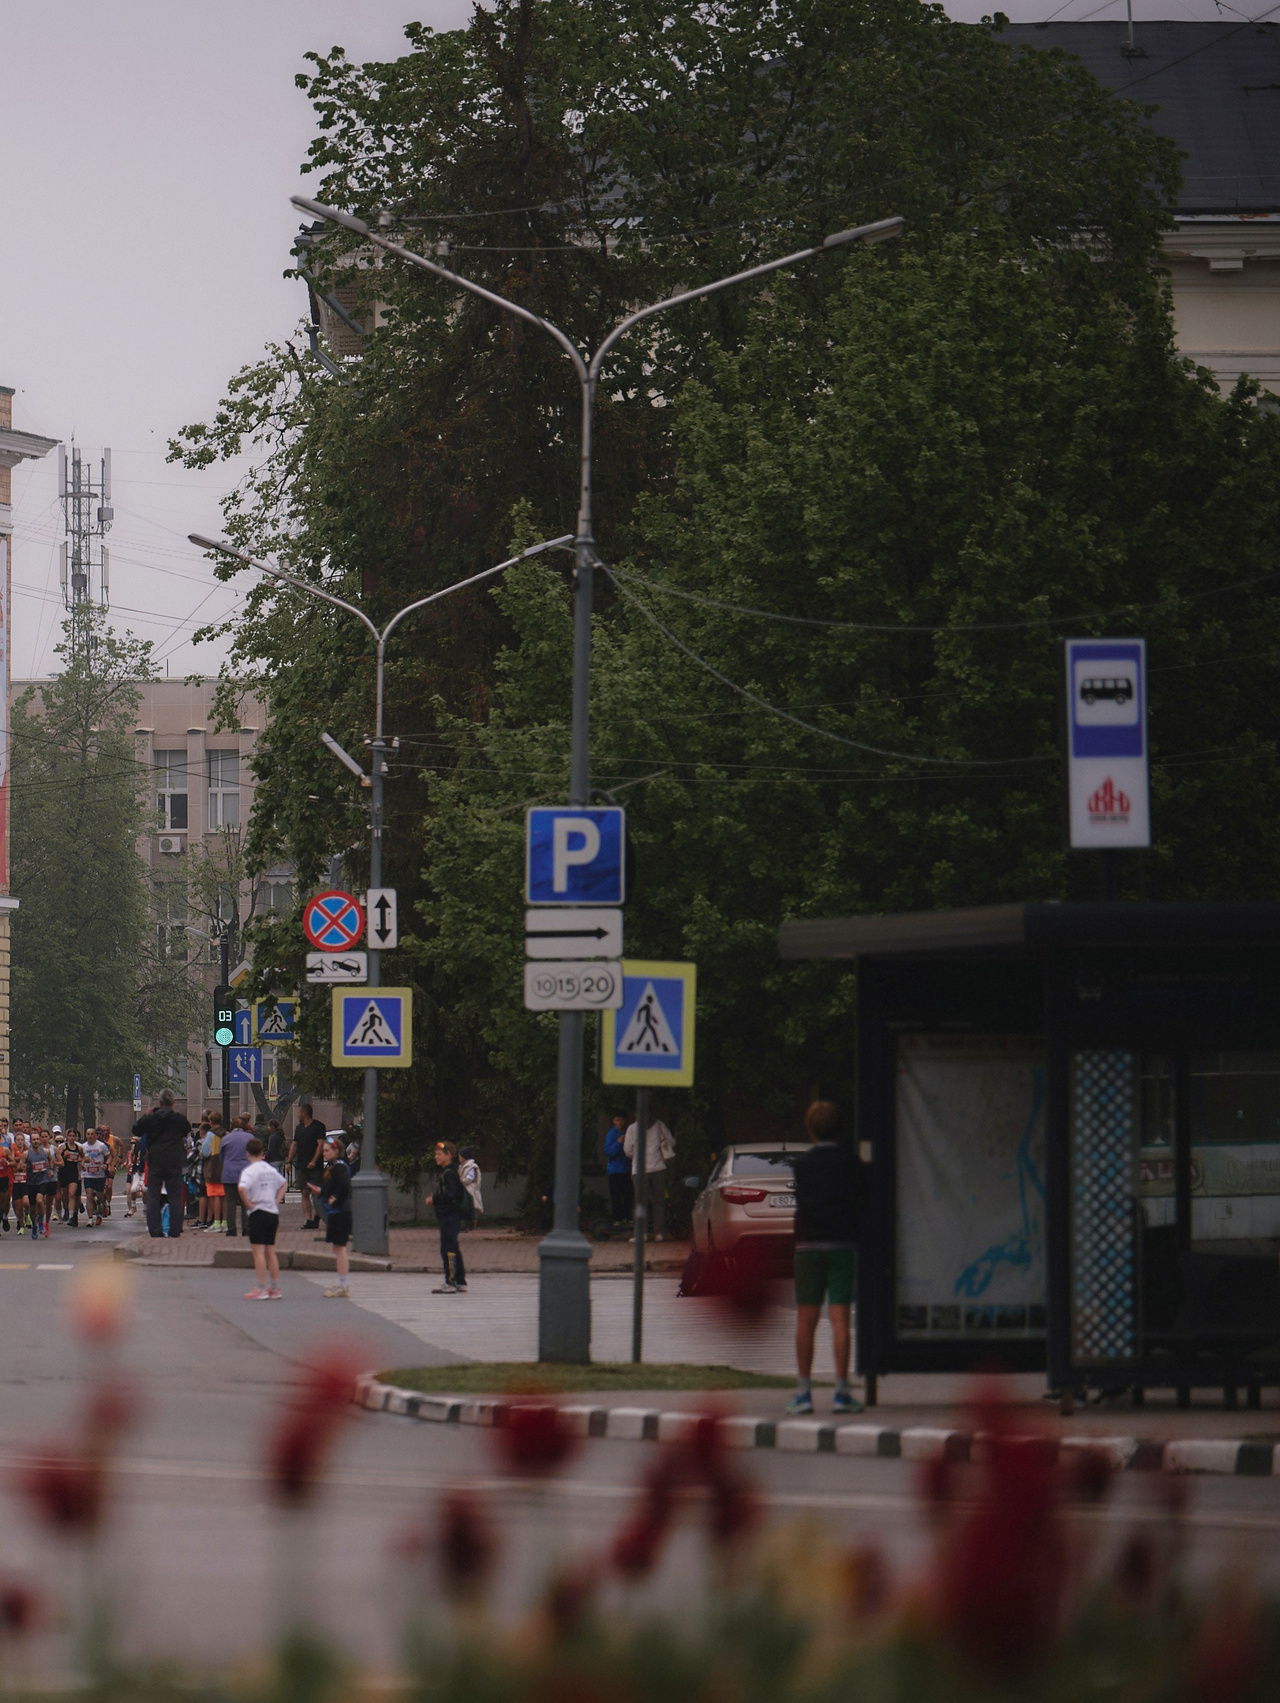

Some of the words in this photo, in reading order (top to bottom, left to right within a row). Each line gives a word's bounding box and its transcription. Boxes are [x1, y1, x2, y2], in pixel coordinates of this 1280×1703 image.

[552, 817, 601, 894] P
[536, 979, 553, 992] 10
[558, 978, 576, 993] 15
[583, 976, 610, 993] 20
[218, 1010, 232, 1022] 03
